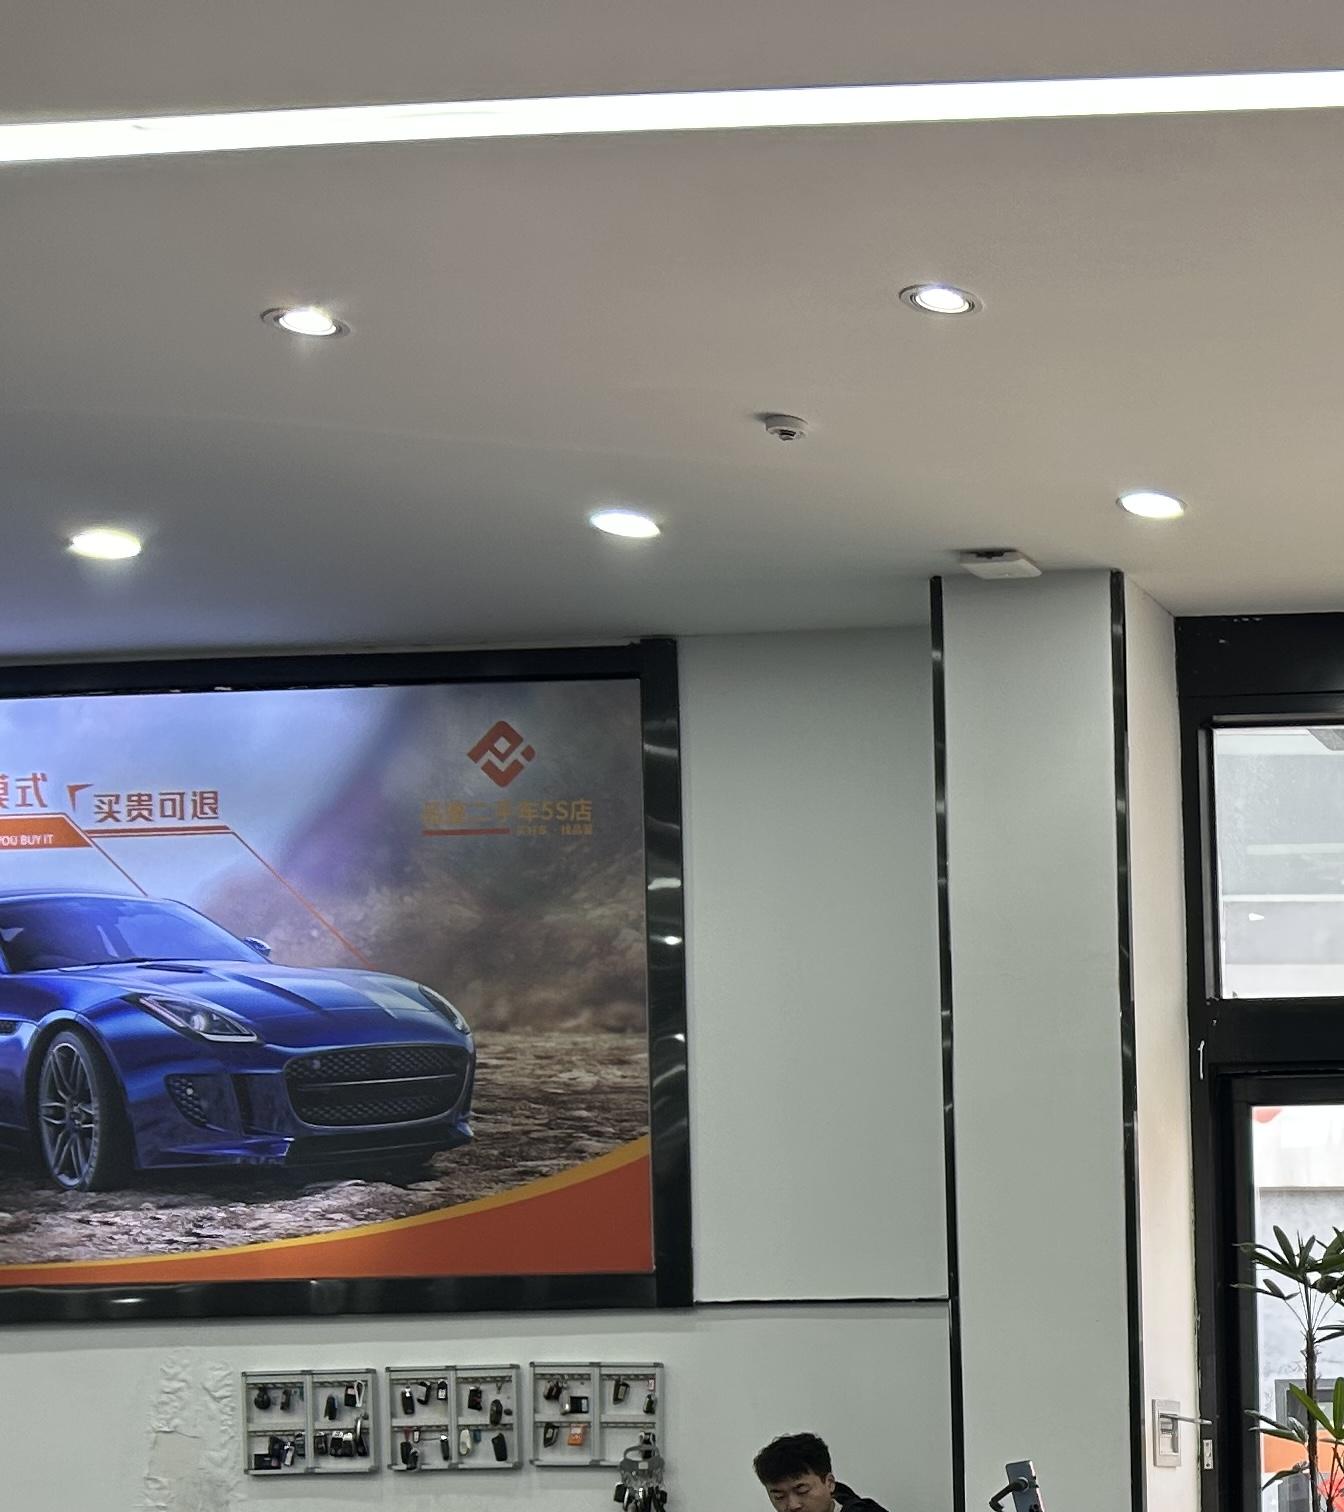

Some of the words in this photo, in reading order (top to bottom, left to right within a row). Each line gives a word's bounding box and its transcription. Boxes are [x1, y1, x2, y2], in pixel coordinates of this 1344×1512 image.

[0, 773, 48, 809] 式
[94, 790, 219, 823] 买贵可退
[0, 835, 18, 846] OU
[20, 834, 41, 846] BUY
[43, 833, 54, 845] IT
